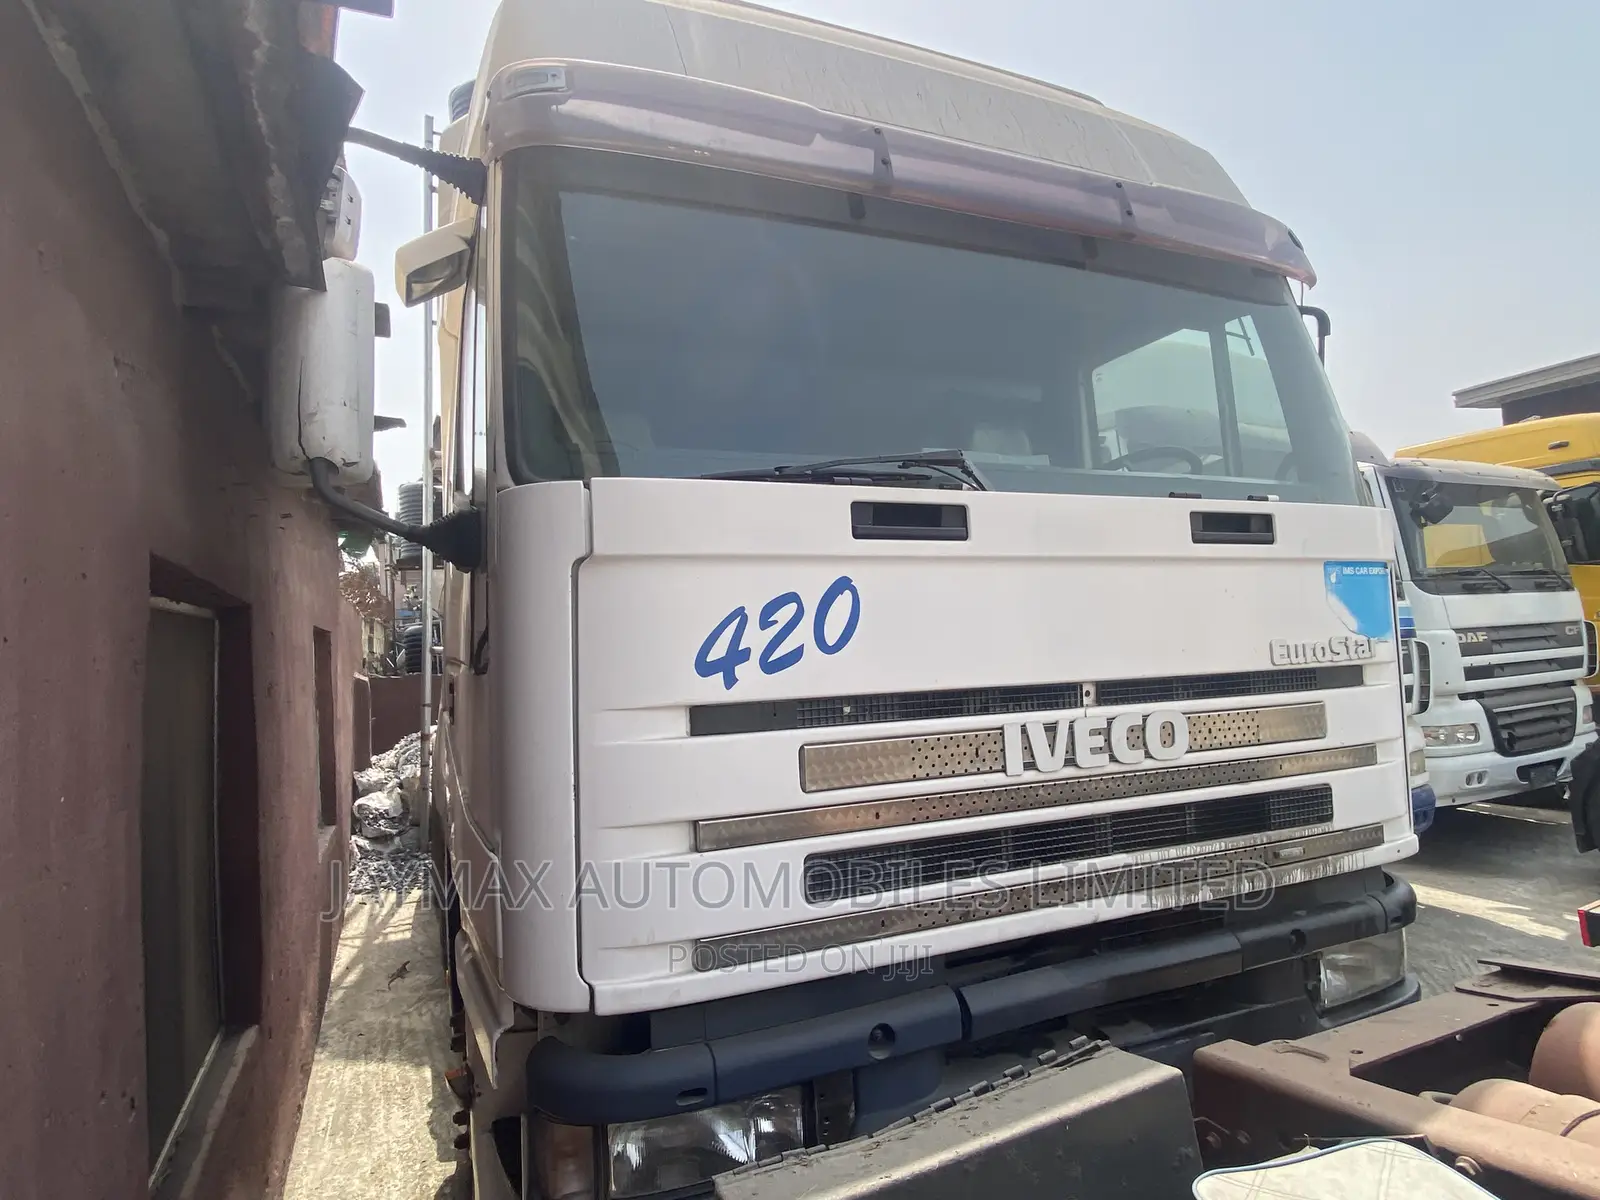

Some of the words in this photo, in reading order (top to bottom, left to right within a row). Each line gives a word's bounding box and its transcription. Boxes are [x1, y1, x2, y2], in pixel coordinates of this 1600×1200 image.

[1355, 566, 1369, 575] CAR
[694, 575, 861, 691] 420
[1456, 631, 1488, 644] DAF
[1002, 709, 1190, 777] IVECO
